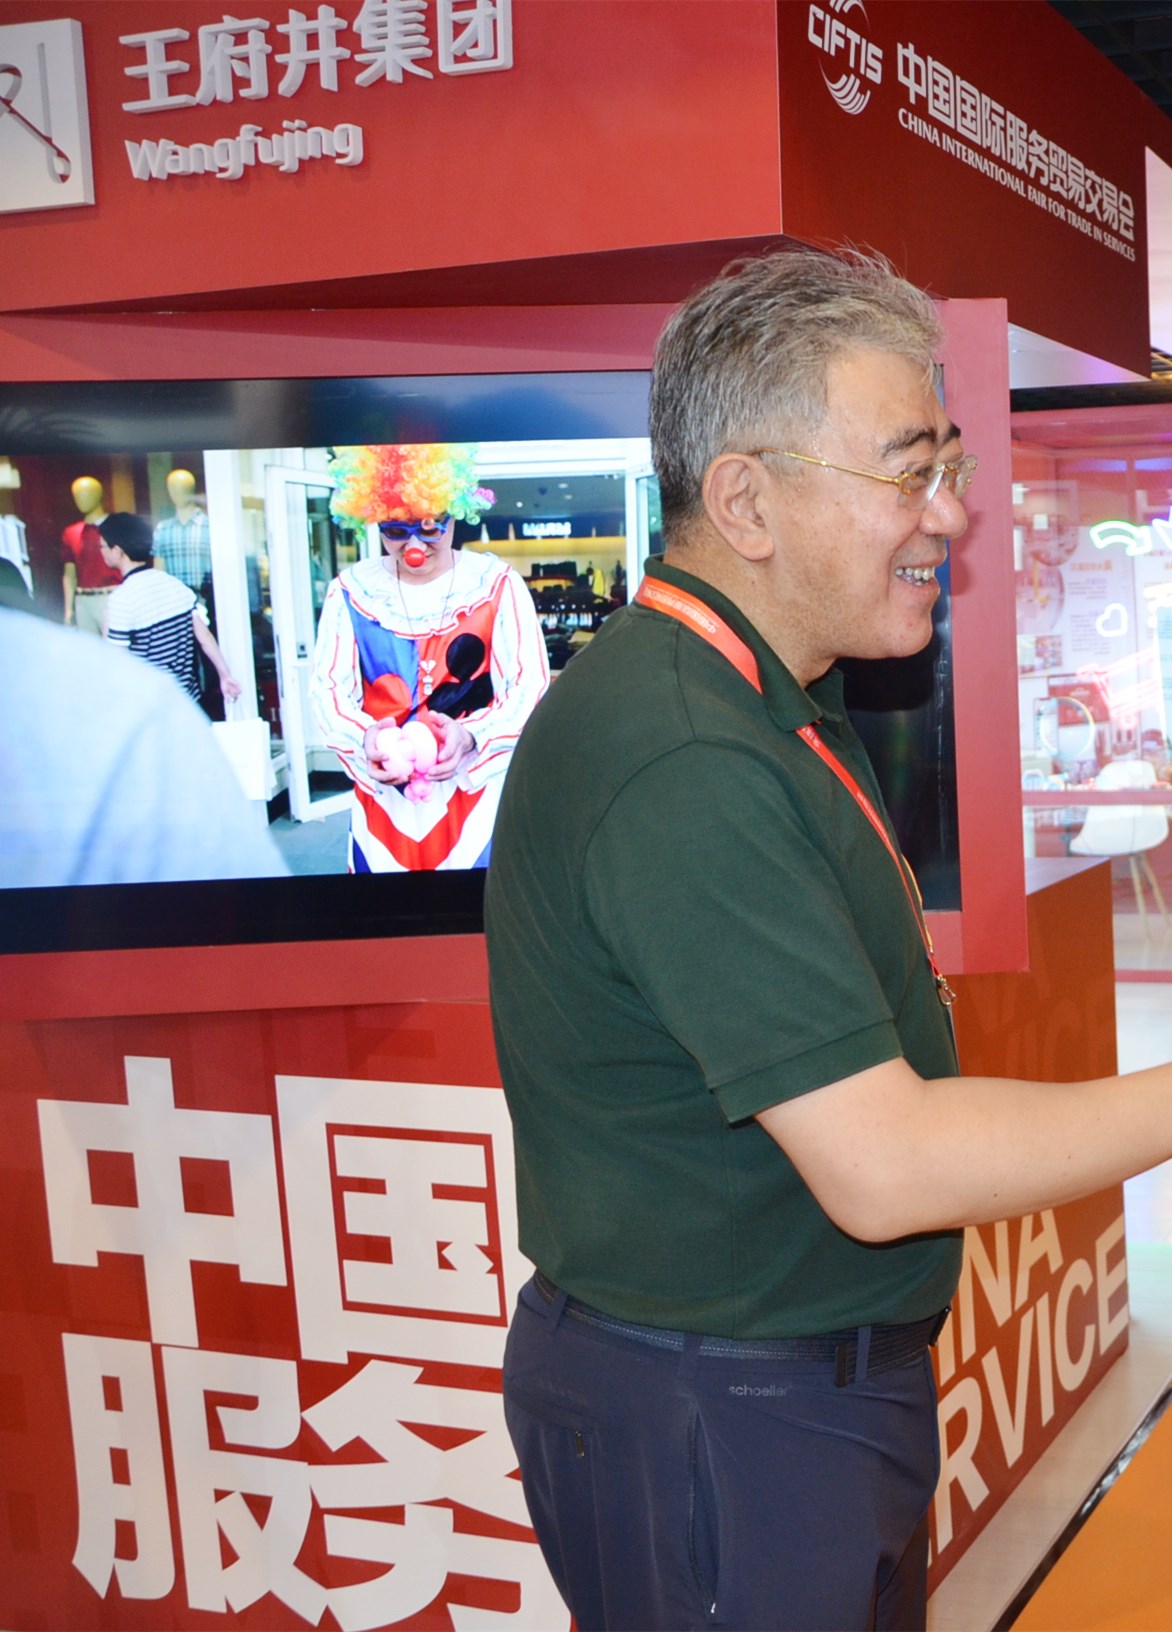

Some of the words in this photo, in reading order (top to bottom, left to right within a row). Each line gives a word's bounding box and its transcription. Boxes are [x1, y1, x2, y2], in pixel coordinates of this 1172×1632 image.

[119, 0, 513, 114] 王府井集团
[808, 3, 883, 85] CIFTIS
[124, 119, 363, 180] Wangfujing
[897, 42, 1135, 241] 中国国际服务贸易交易会
[898, 107, 941, 148] CHINA
[941, 132, 1026, 198] INTERNATIONAL
[1027, 184, 1048, 210] FAIR
[1048, 197, 1066, 221] FOR
[1067, 208, 1093, 237] TRADE
[1093, 223, 1103, 243] IN
[1103, 230, 1136, 262] SERVICES
[37, 1055, 536, 1369] 中国
[927, 1213, 1130, 1569] RVICE
[62, 1332, 571, 1632] 服务
